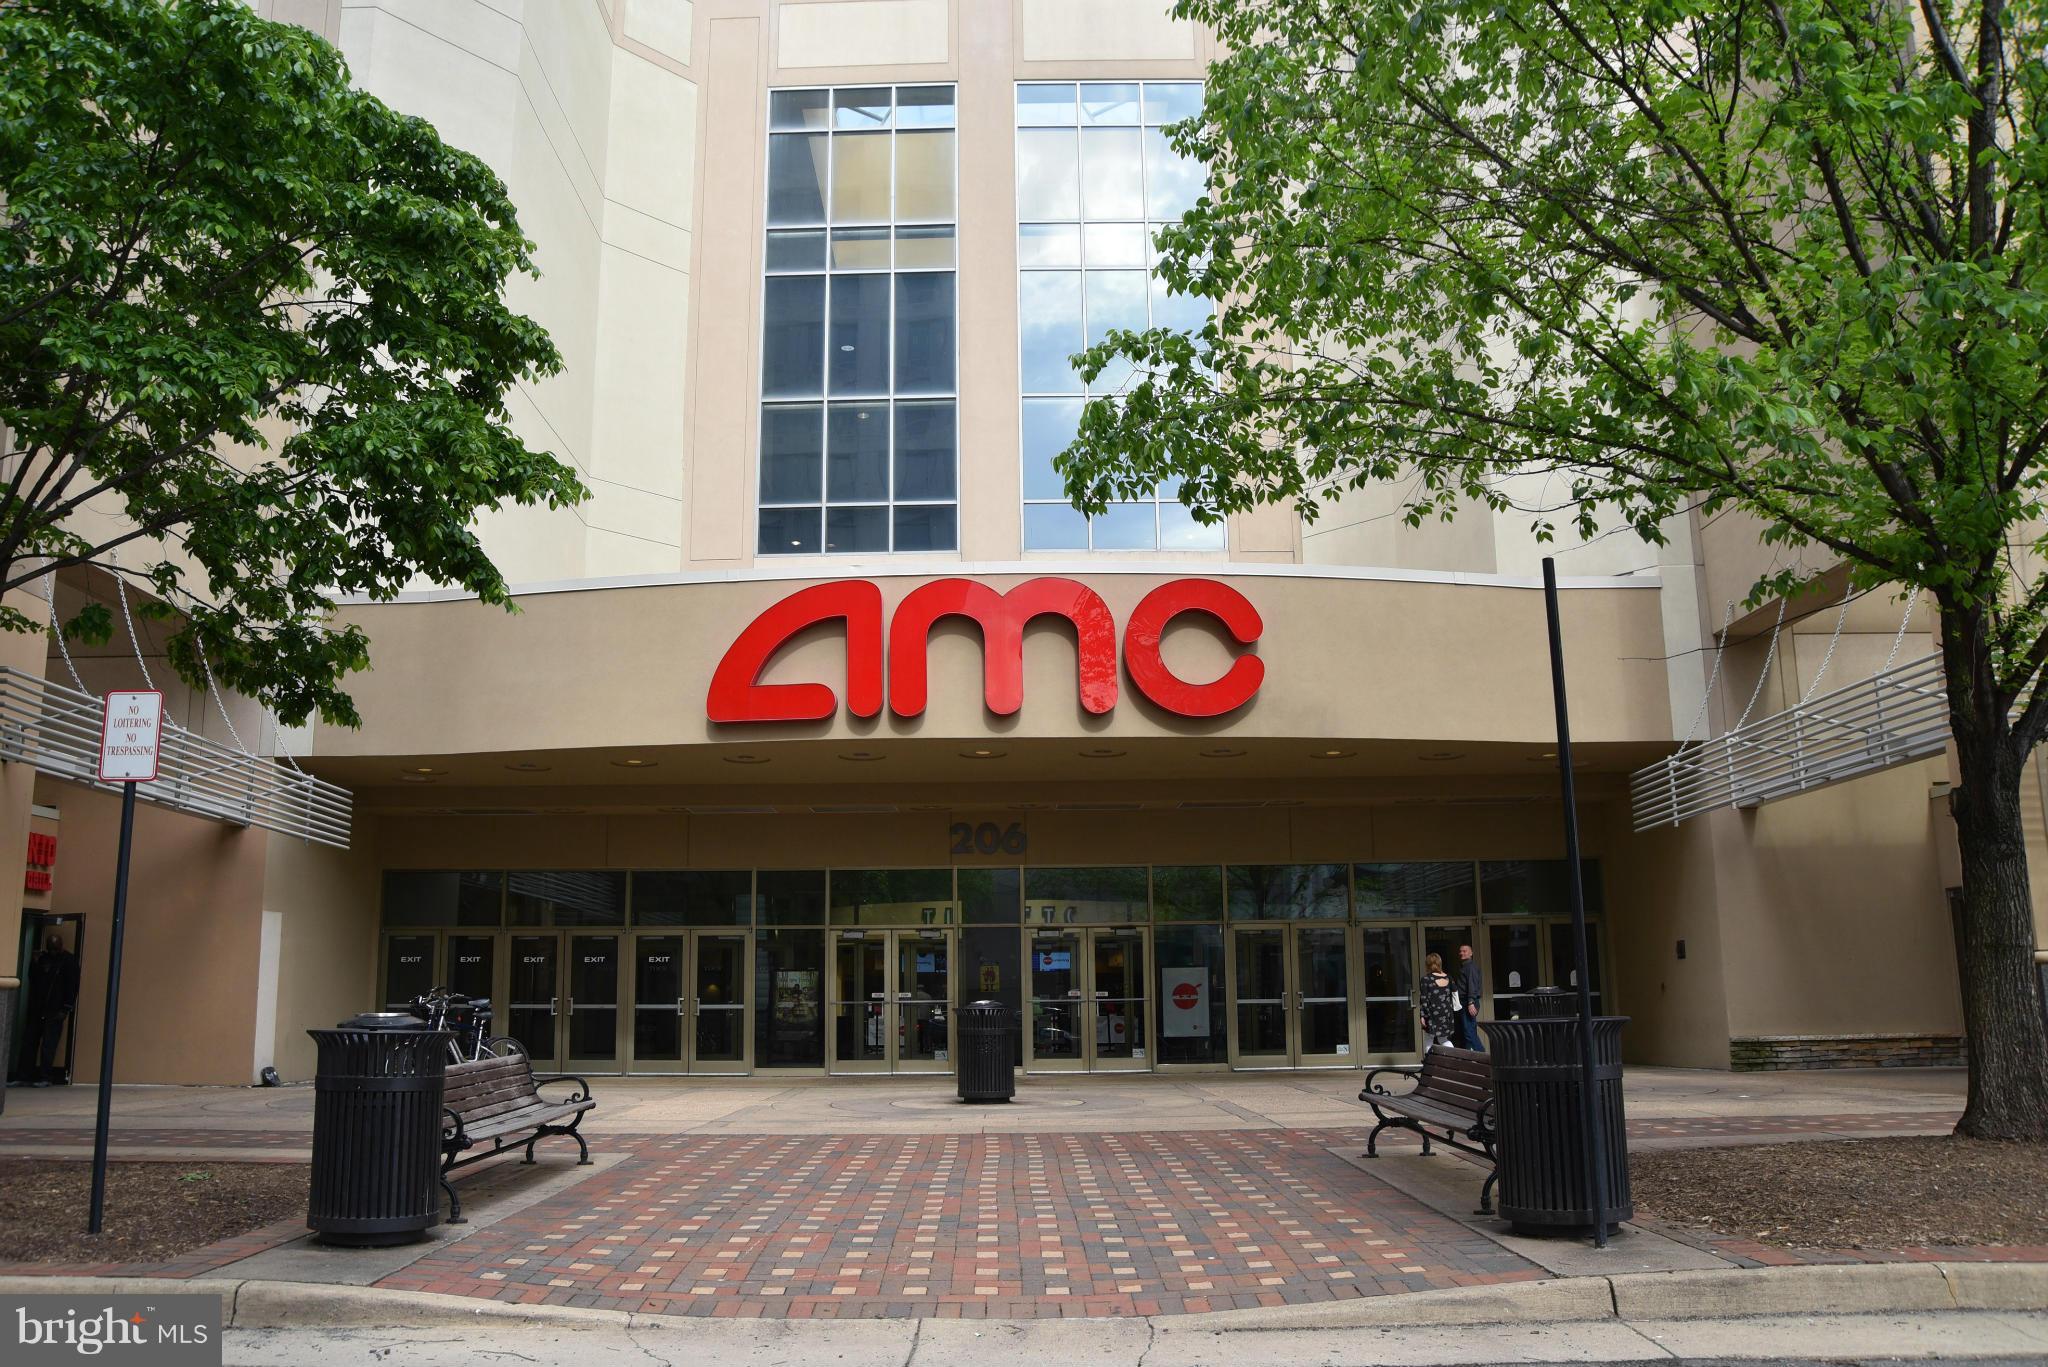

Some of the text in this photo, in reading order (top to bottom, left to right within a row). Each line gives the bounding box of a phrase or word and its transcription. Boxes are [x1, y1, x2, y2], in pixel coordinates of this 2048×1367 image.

[128, 705, 139, 715] NO
[113, 718, 152, 728] LOITERING
[125, 733, 137, 743] NO
[107, 745, 154, 756] TRESPASSING
[950, 822, 1026, 855] 206
